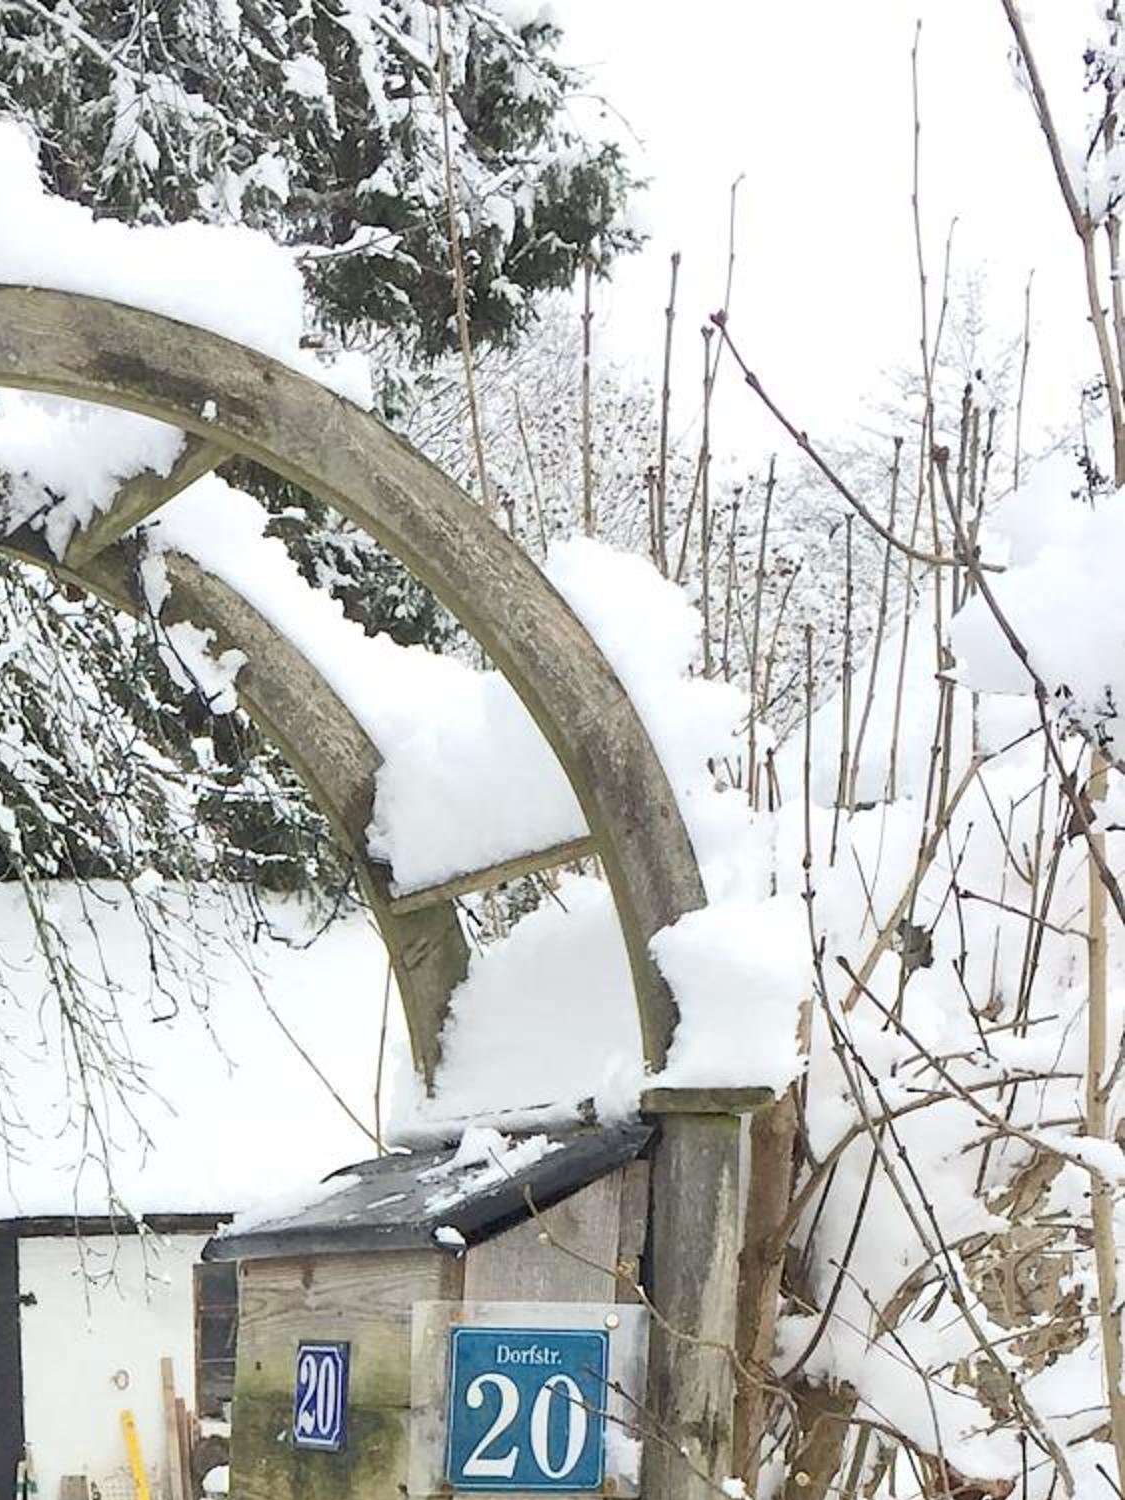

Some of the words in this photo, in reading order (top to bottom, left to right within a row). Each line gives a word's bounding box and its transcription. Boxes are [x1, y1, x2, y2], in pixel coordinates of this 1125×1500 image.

[299, 1354, 336, 1436] 20
[496, 1344, 563, 1365] Dorfstr.
[462, 1372, 588, 1480] 20
